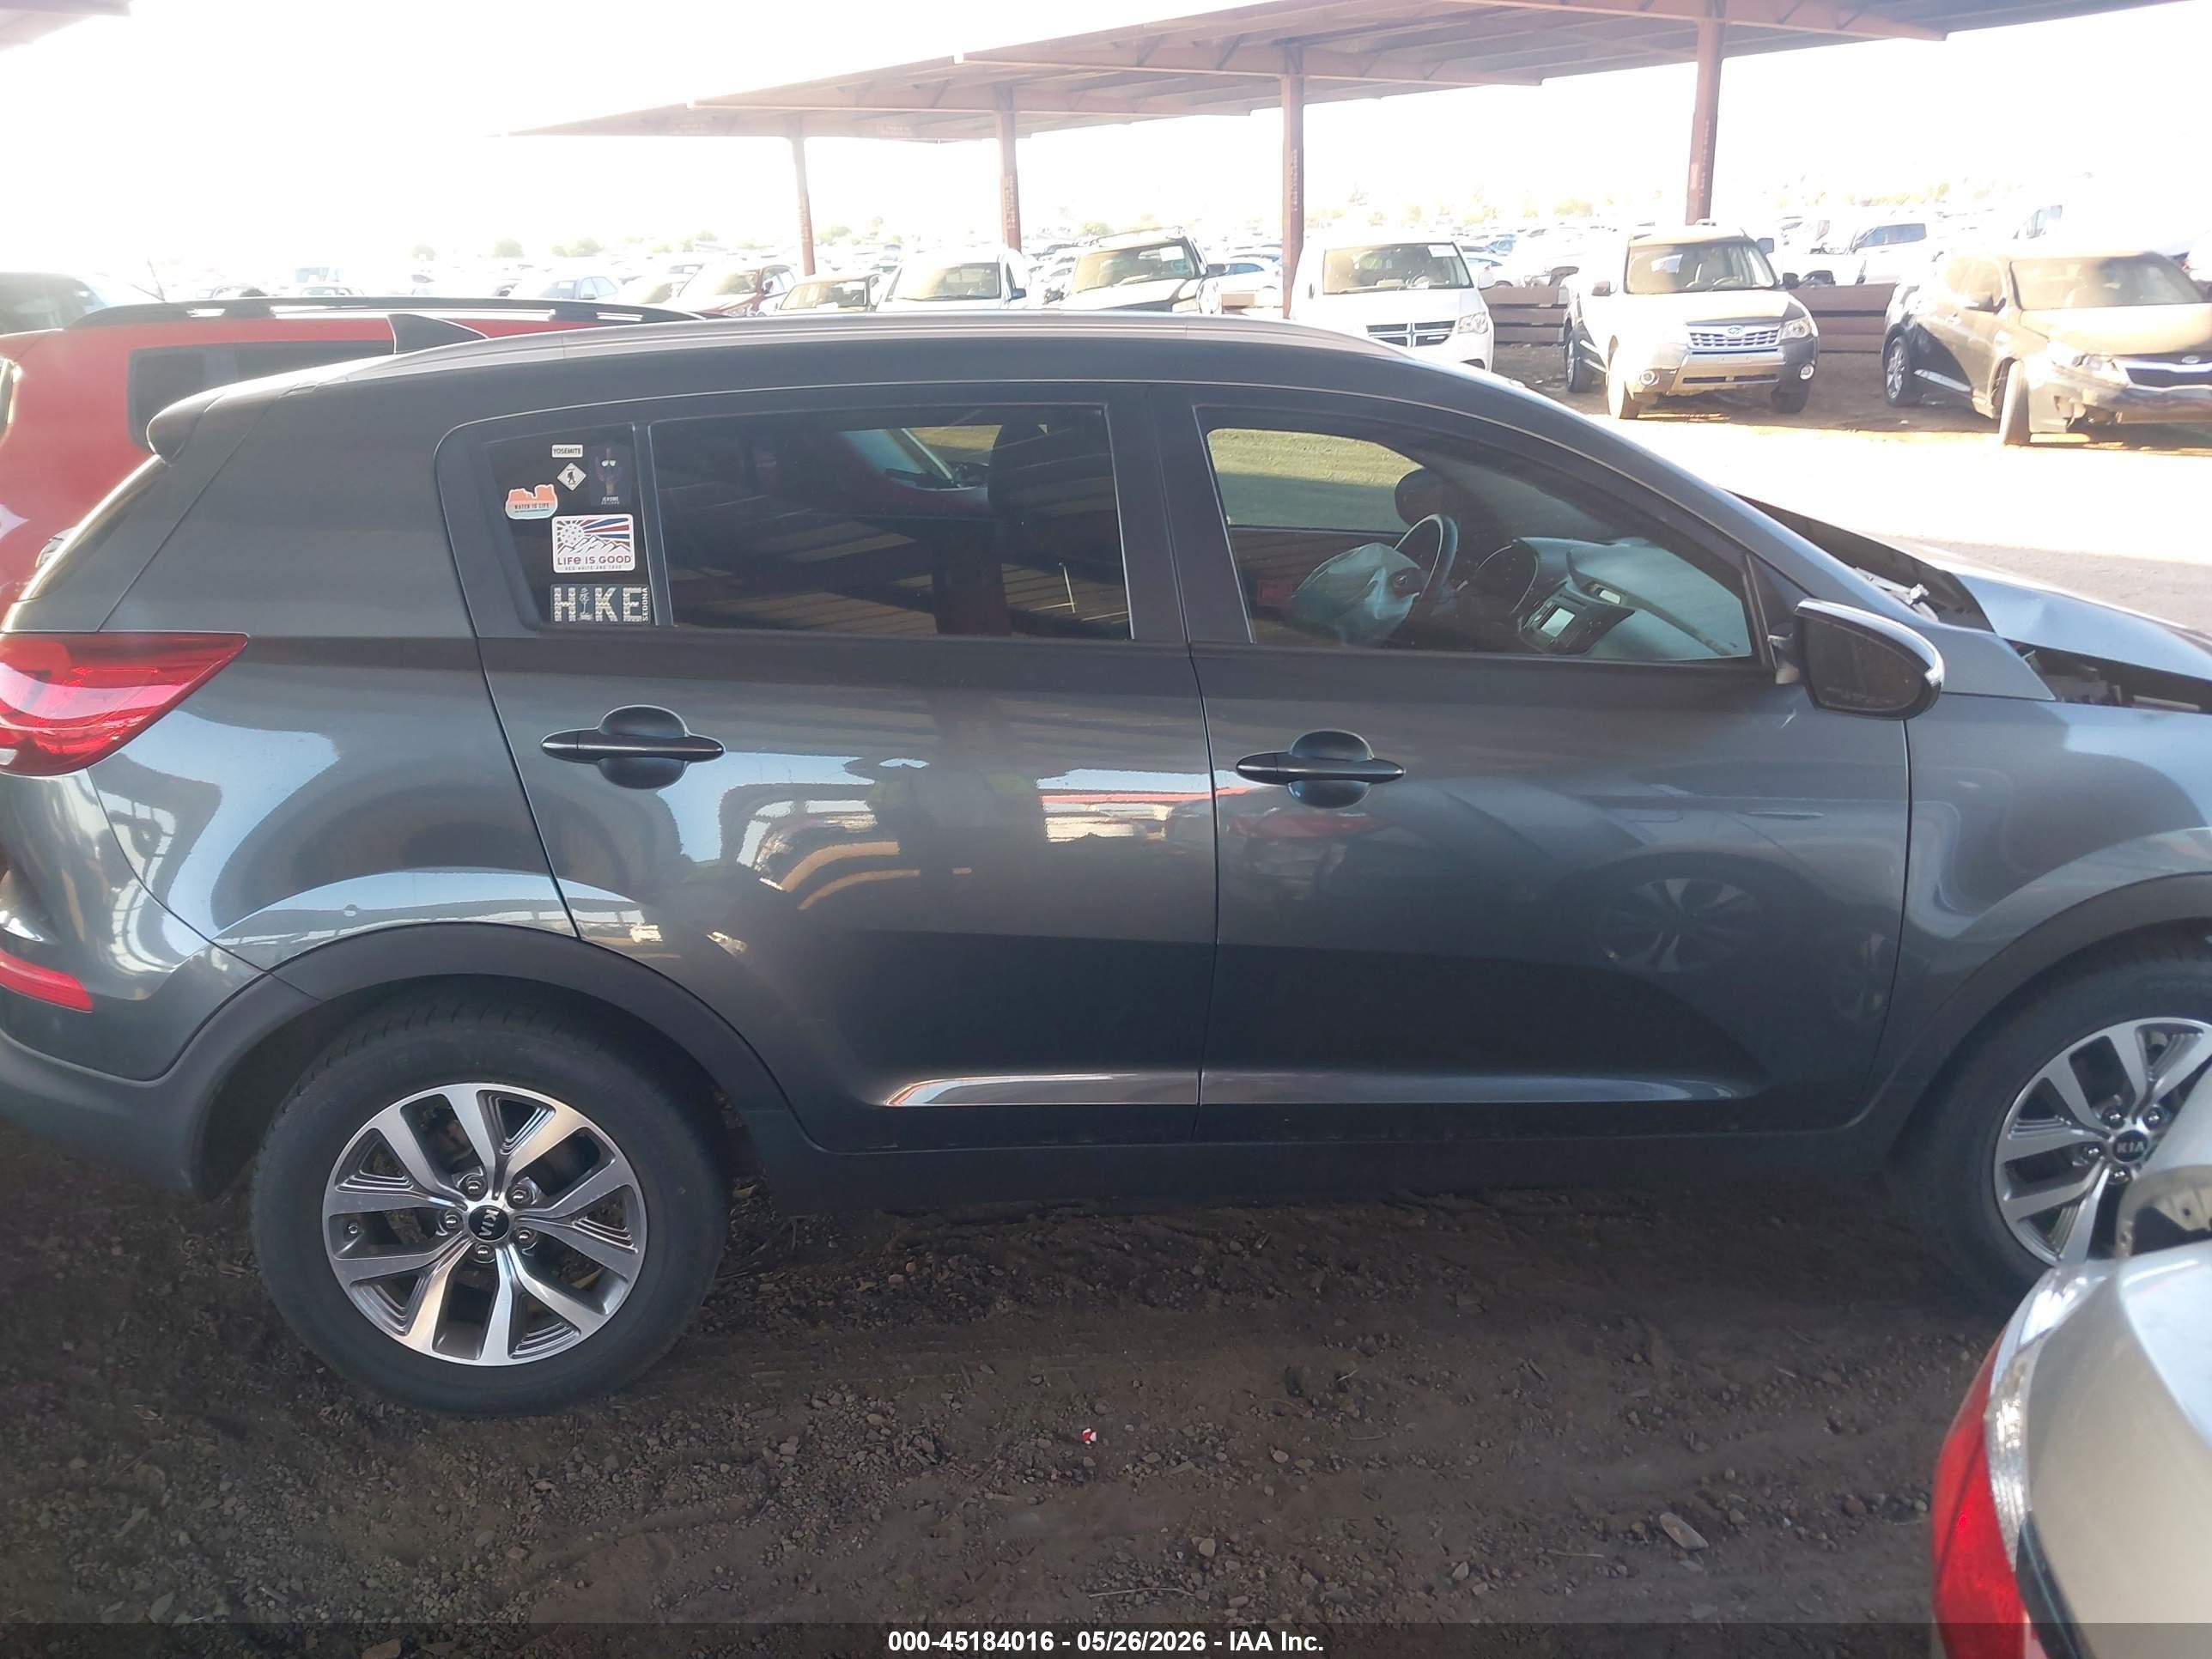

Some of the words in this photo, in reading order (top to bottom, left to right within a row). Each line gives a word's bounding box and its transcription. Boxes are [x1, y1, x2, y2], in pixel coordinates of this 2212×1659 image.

[585, 556, 596, 564] IS
[599, 555, 632, 564] GOOD
[2116, 1140, 2145, 1153] KIA
[478, 1209, 500, 1237] KIA
